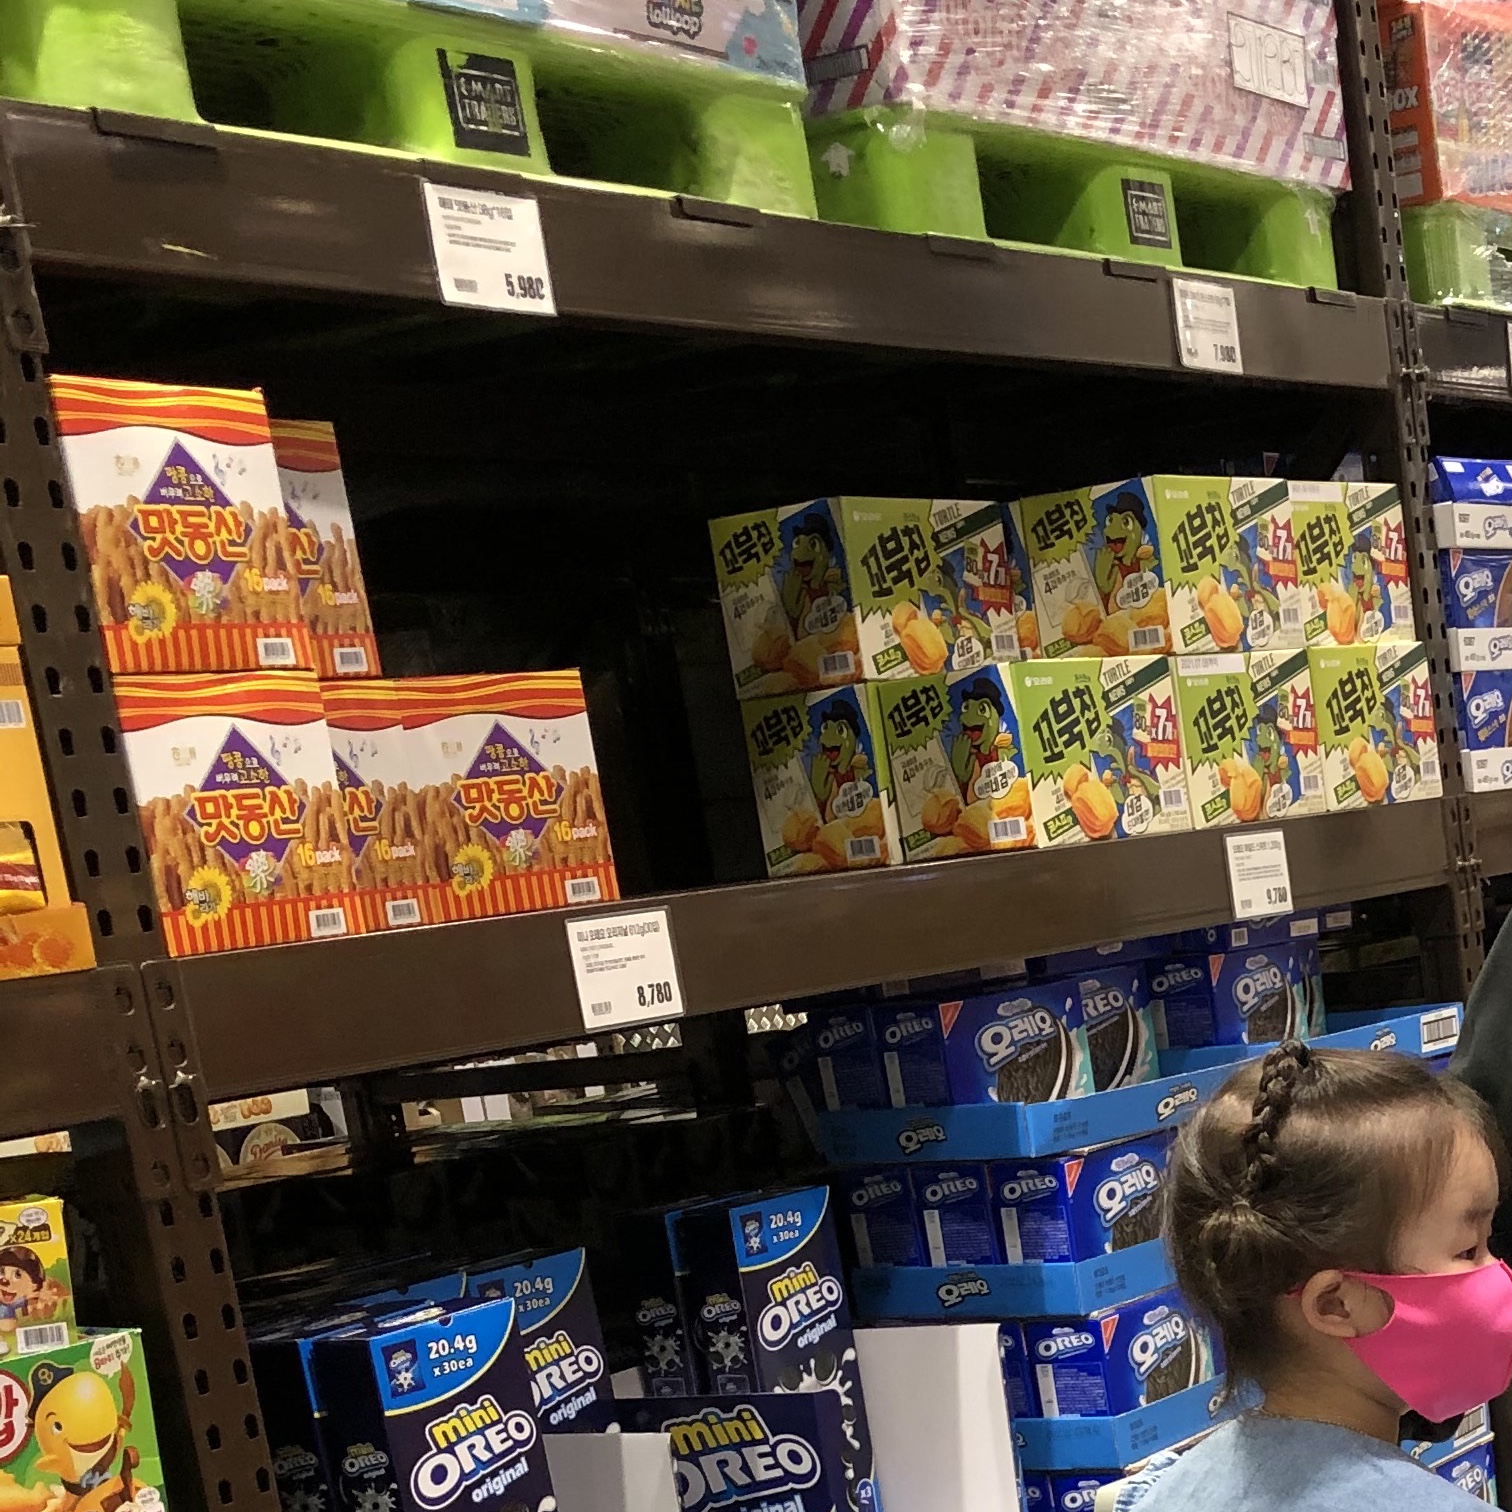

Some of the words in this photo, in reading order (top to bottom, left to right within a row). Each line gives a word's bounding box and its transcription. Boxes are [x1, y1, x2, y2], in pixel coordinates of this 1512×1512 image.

[1230, 480, 1256, 504] TURTLE
[932, 502, 963, 526] TURTLE
[1030, 498, 1089, 552] 꼬북칩
[135, 505, 250, 563] 맛동산
[718, 519, 776, 577] 꼬북칩
[1170, 501, 1231, 574] 꼬북칩
[1296, 513, 1346, 577] 꼬북칩
[245, 567, 264, 592] 16
[860, 523, 932, 599] 꼬북칩
[317, 583, 337, 606] 16
[1457, 568, 1495, 606] 오레오
[1102, 659, 1132, 687] TURTLE
[1251, 653, 1275, 676] TURTLE
[887, 683, 944, 740] 꼬북칩
[1192, 684, 1249, 755] 꼬북칩
[1326, 667, 1378, 737] 꼬북칩
[1467, 688, 1506, 729] 오레오
[750, 704, 806, 757] 꼬북칩
[1032, 684, 1101, 765] 꼬북칩
[192, 787, 303, 847] 맛동산
[457, 772, 560, 828] 맛동산
[554, 820, 572, 842] 16
[571, 823, 598, 841] pack
[296, 841, 317, 867] 16
[315, 844, 341, 865] pack
[373, 839, 392, 862] 16
[391, 839, 416, 860] pack
[636, 980, 673, 1008] 8,780
[1152, 966, 1204, 995] OREO
[1235, 963, 1284, 1010] 오레오
[817, 1018, 865, 1049] OREO
[884, 1016, 933, 1045] OREO
[976, 1008, 1056, 1071] 오레오
[1156, 1086, 1199, 1121] 오레오
[898, 1124, 948, 1154] 오레오
[924, 1174, 978, 1203] OREO
[1002, 1174, 1059, 1201] OREO
[1093, 1163, 1160, 1227] 오레오
[769, 1208, 803, 1231] 20.4g
[513, 1276, 554, 1297] 20.4g
[769, 1265, 820, 1304] mini
[937, 1277, 991, 1308] 오레오
[702, 1302, 741, 1322] OREO
[758, 1276, 843, 1350] OREO
[428, 1331, 479, 1360] 20.4g
[796, 1314, 837, 1350] original
[1037, 1331, 1095, 1358] OREO
[1128, 1314, 1187, 1379] 오레오
[431, 1398, 503, 1450] mini
[549, 1386, 597, 1425] original
[670, 1410, 765, 1456] mini
[345, 1452, 389, 1474] OREO
[414, 1414, 536, 1506] OREO
[471, 1456, 530, 1504] original
[859, 1486, 873, 1501] x3
